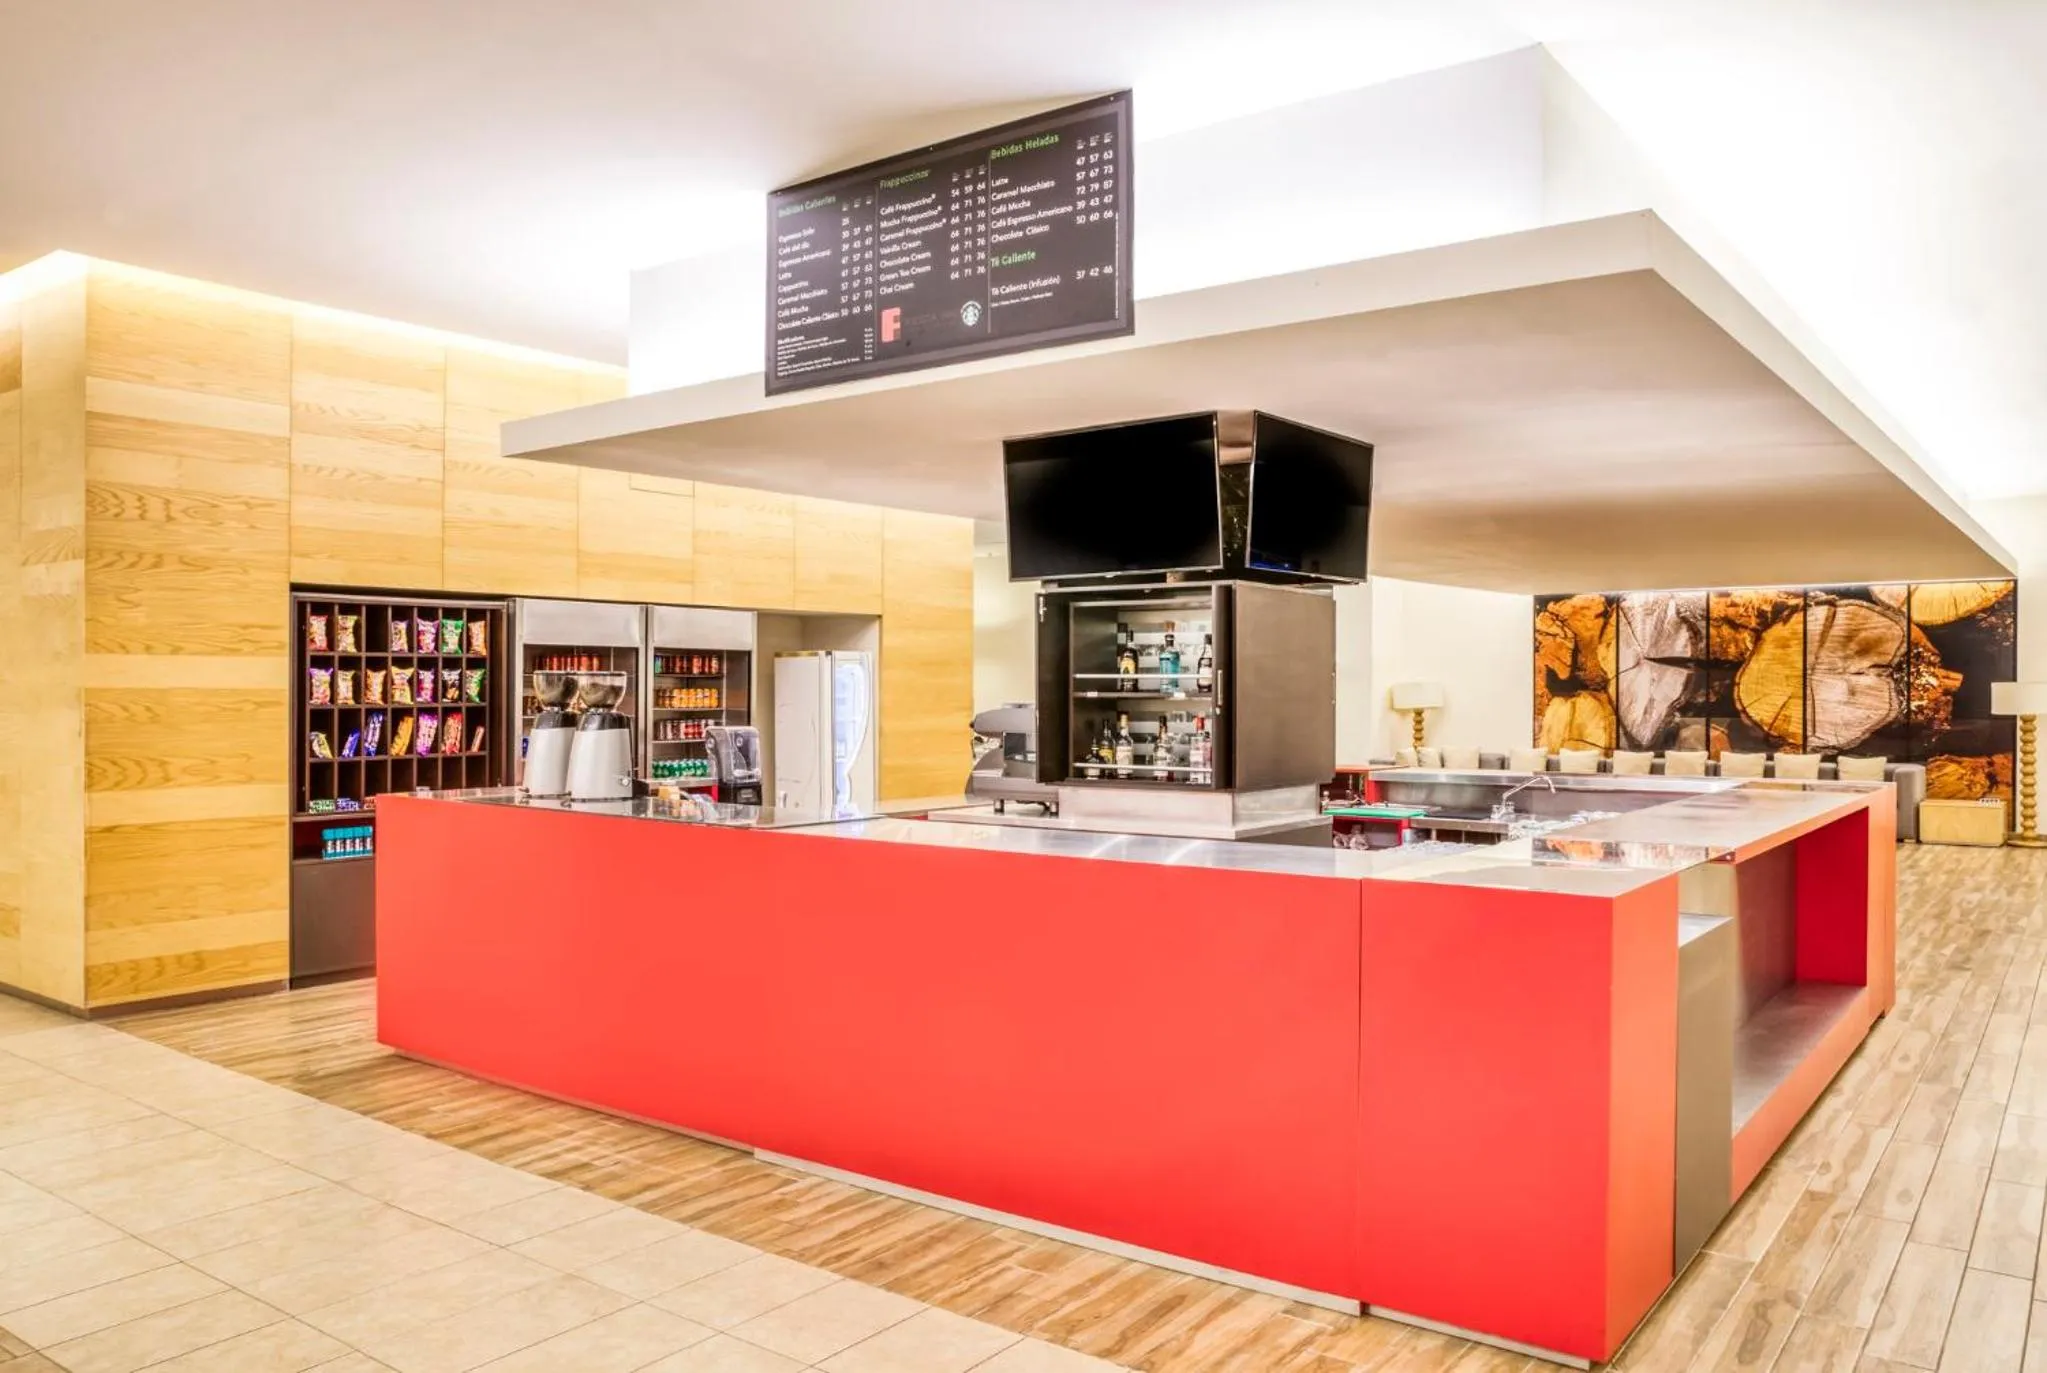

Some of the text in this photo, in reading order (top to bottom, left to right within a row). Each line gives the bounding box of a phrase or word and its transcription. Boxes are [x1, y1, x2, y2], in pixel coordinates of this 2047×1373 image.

[991, 144, 1023, 160] Bebidas
[1025, 134, 1060, 150] Heladas
[991, 178, 1009, 187] Latte
[1089, 153, 1100, 163] 57
[1103, 150, 1114, 160] 63
[991, 187, 1019, 201] Caramel
[1076, 171, 1086, 181] 57
[1089, 168, 1100, 178] 67
[1103, 165, 1114, 175] 73
[950, 201, 960, 212] 64
[963, 199, 973, 210] 71
[991, 203, 1007, 215] Café
[1076, 185, 1086, 195] 72
[1089, 182, 1100, 193] 79
[1037, 205, 1073, 219] Americano
[1089, 197, 1100, 207] 43
[880, 229, 905, 242] Caramel
[963, 213, 973, 224] 71
[963, 227, 973, 238] 71
[991, 229, 1024, 243] Chocolate
[1076, 214, 1086, 224] 50
[1089, 212, 1100, 222] 60
[1103, 209, 1114, 219] 66
[910, 251, 932, 262] Cream
[963, 241, 973, 252] 71
[1001, 250, 1037, 266] Caliente
[910, 265, 932, 275] Cream
[963, 255, 973, 266] 71
[963, 269, 973, 280] 71
[1000, 281, 1028, 295] Caliente
[1076, 269, 1086, 280] 37
[1089, 267, 1100, 277] 42
